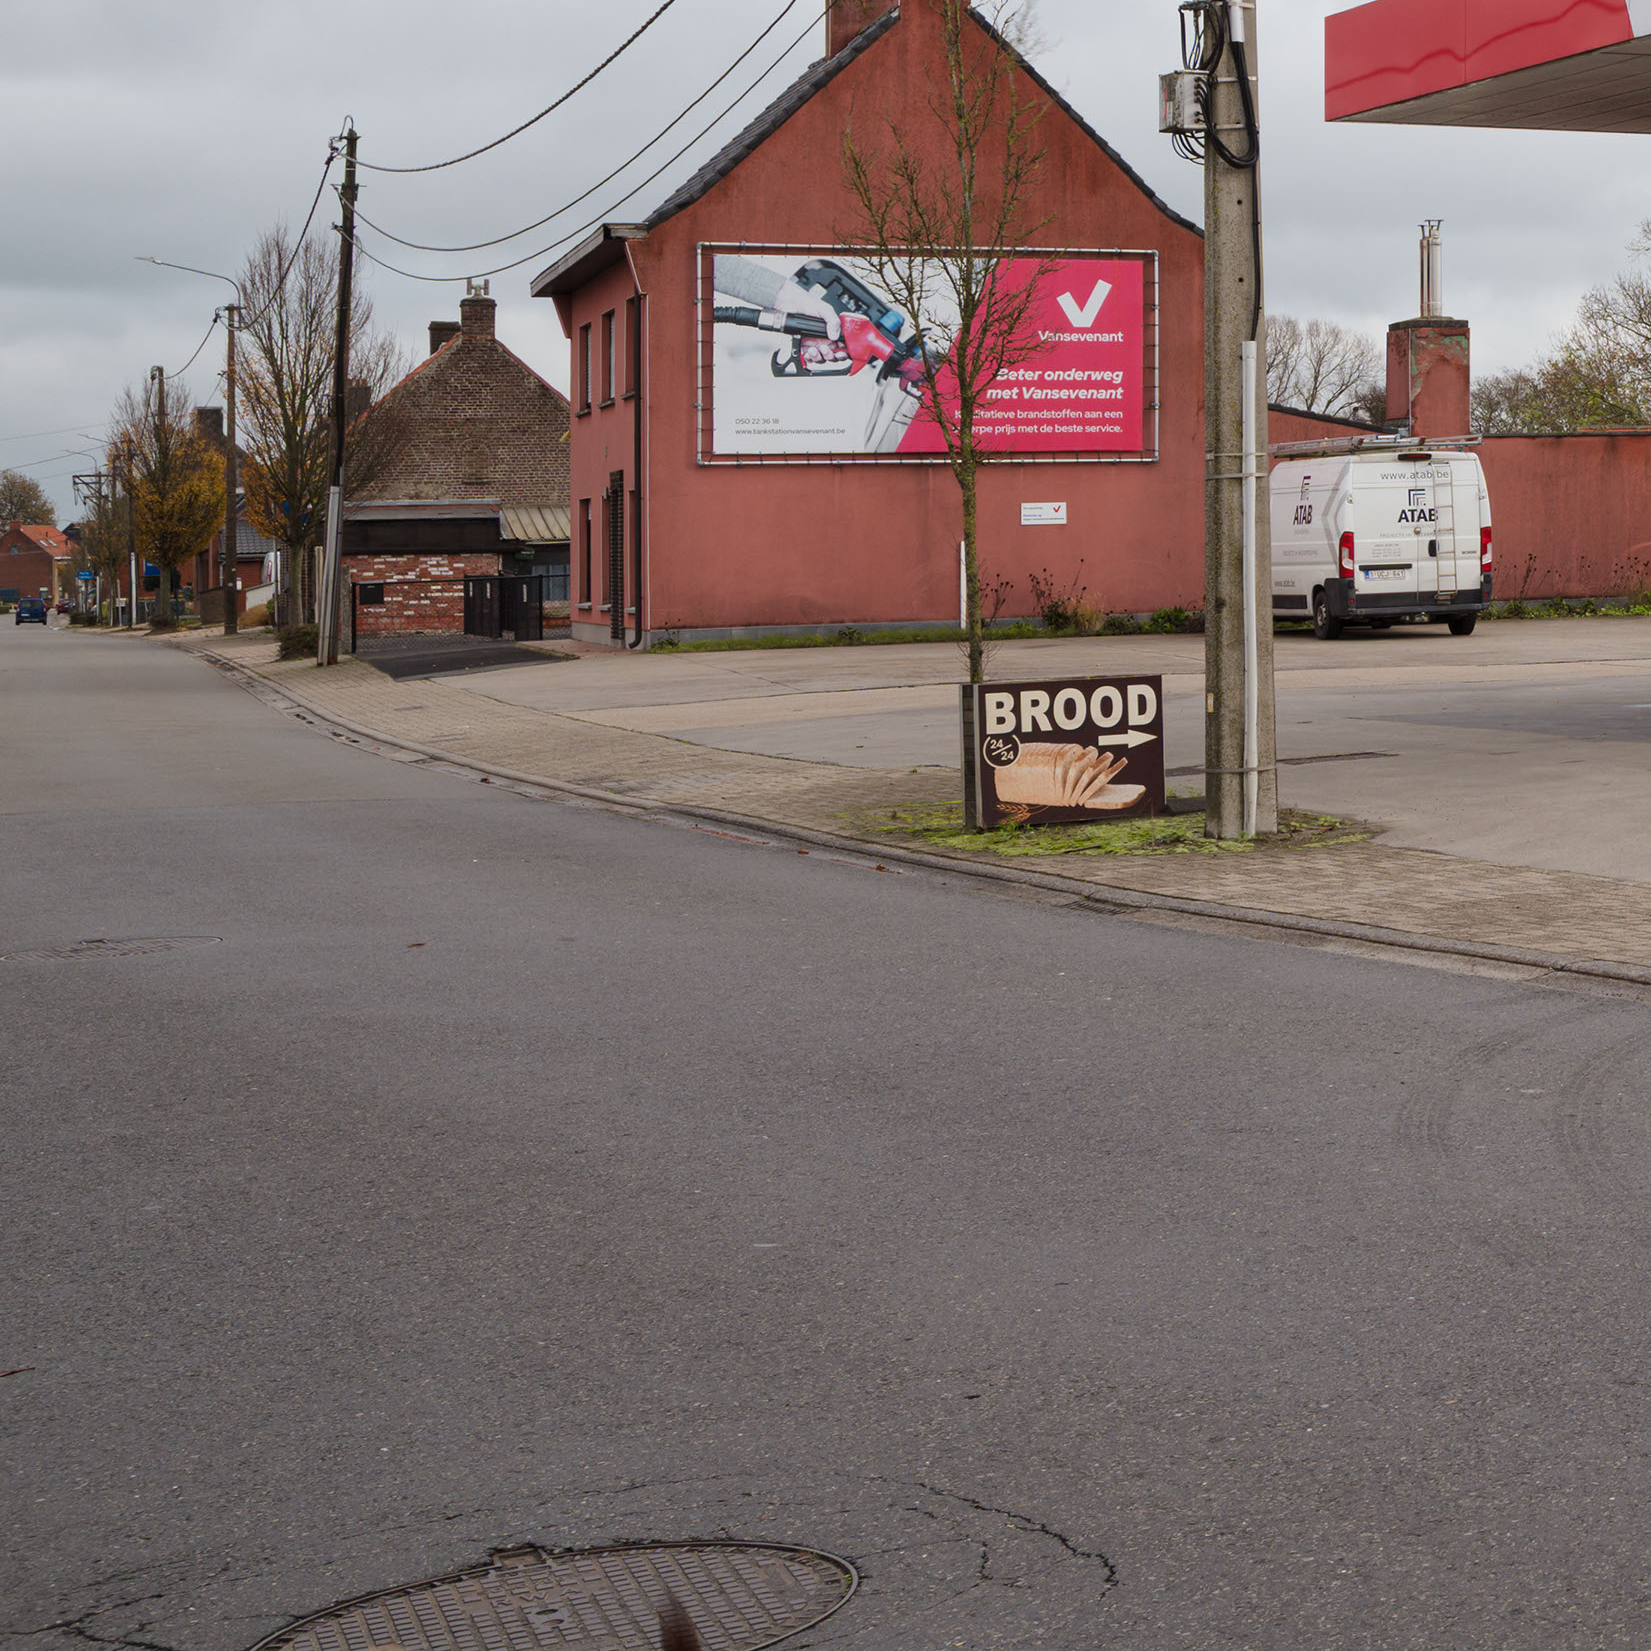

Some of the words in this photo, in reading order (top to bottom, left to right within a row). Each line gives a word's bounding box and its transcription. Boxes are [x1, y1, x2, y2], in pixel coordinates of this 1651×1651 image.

[1038, 330, 1124, 342] Vansevenant
[996, 367, 1042, 381] Beter
[1044, 367, 1124, 384] onderweg
[986, 387, 1019, 399] met
[1022, 386, 1124, 399] Vansevenant
[1017, 409, 1083, 419] brandstoffen
[1084, 411, 1103, 419] aan
[1104, 411, 1124, 419] een
[995, 424, 1016, 435] prijs
[1018, 425, 1038, 434] met
[1040, 424, 1053, 434] de
[1055, 424, 1083, 434] beste
[1085, 424, 1124, 434] service.
[1380, 469, 1449, 480] www.atabbe
[1292, 504, 1313, 526] ATAB
[1397, 508, 1439, 523] ATAB
[984, 683, 1158, 735] BROOD
